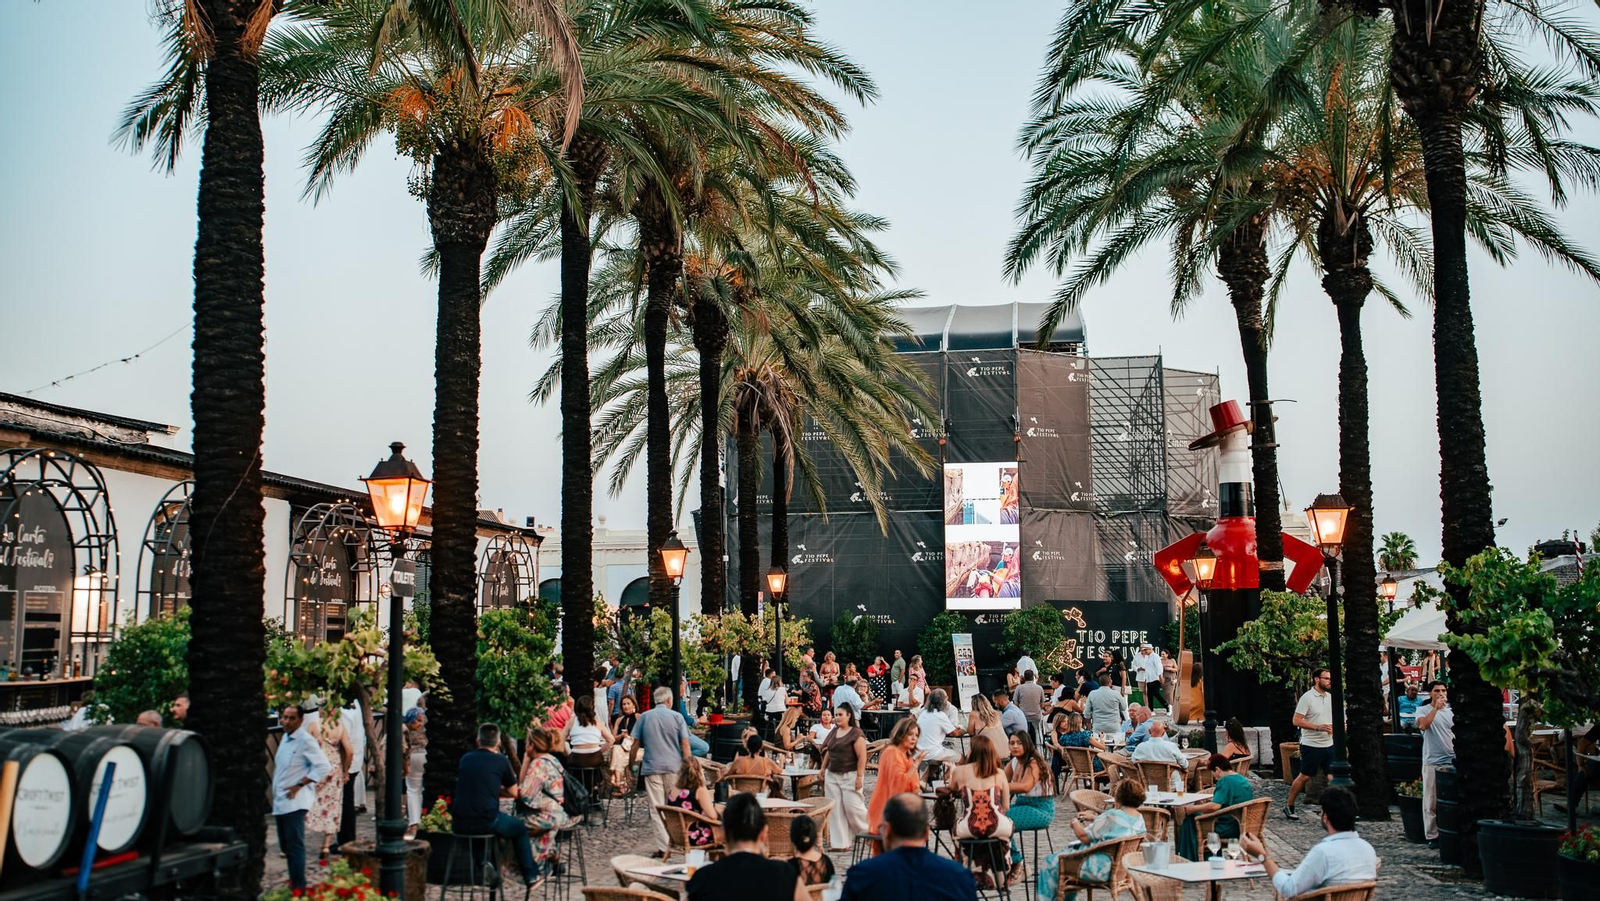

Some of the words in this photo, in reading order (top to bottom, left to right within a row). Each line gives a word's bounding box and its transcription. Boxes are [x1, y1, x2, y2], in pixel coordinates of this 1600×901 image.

[2, 523, 15, 544] La
[17, 523, 47, 545] Carta
[11, 546, 50, 568] Festival
[1076, 629, 1106, 644] TIO
[1111, 629, 1148, 644] PEPE
[1076, 645, 1160, 660] FESTIV
